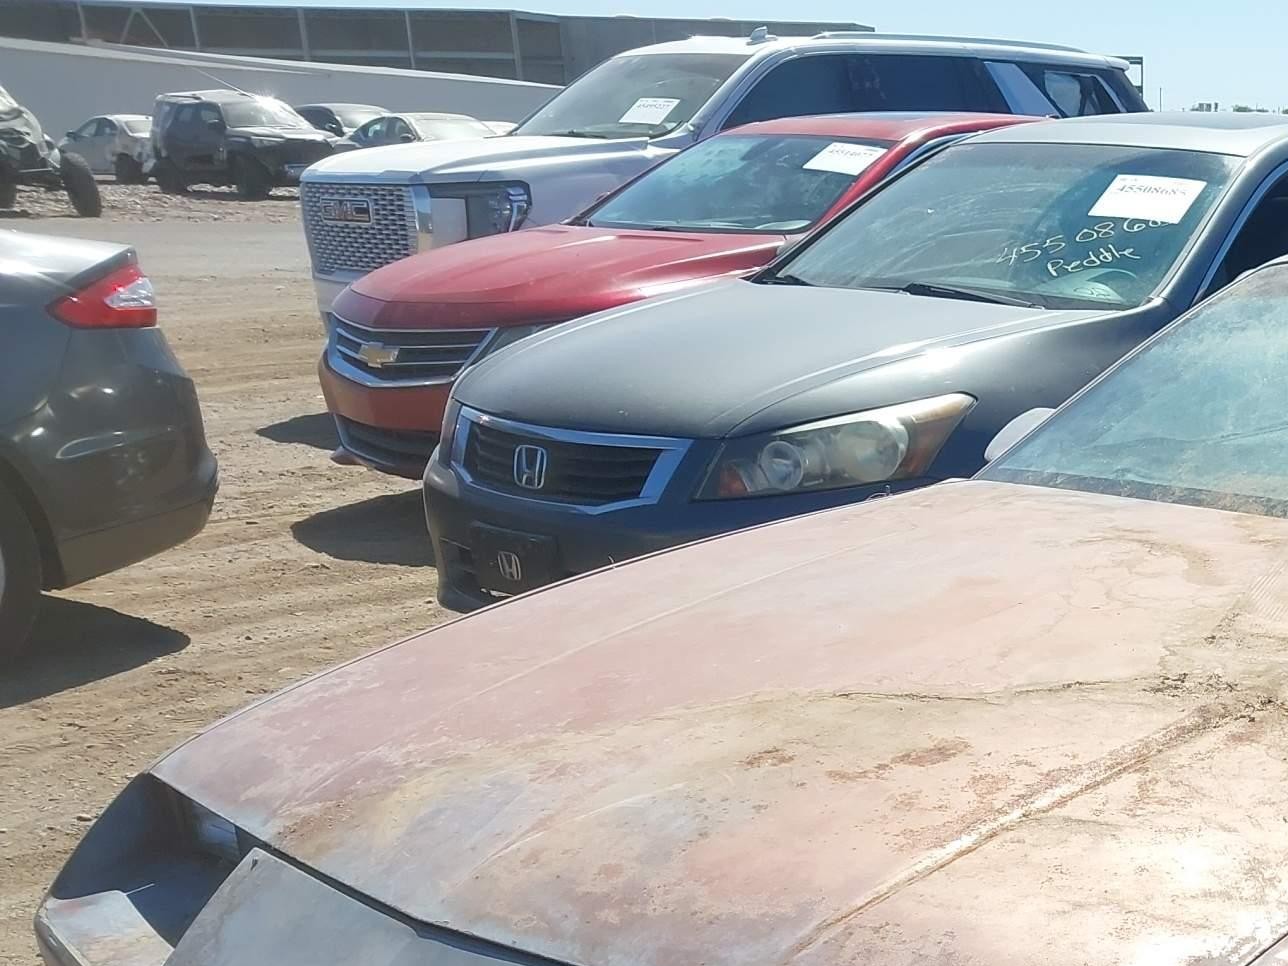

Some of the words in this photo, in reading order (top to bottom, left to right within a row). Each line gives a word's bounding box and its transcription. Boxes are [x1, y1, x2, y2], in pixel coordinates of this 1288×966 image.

[321, 199, 370, 223] GMC
[996, 234, 1066, 266] 455
[1046, 244, 1142, 278] Peddle
